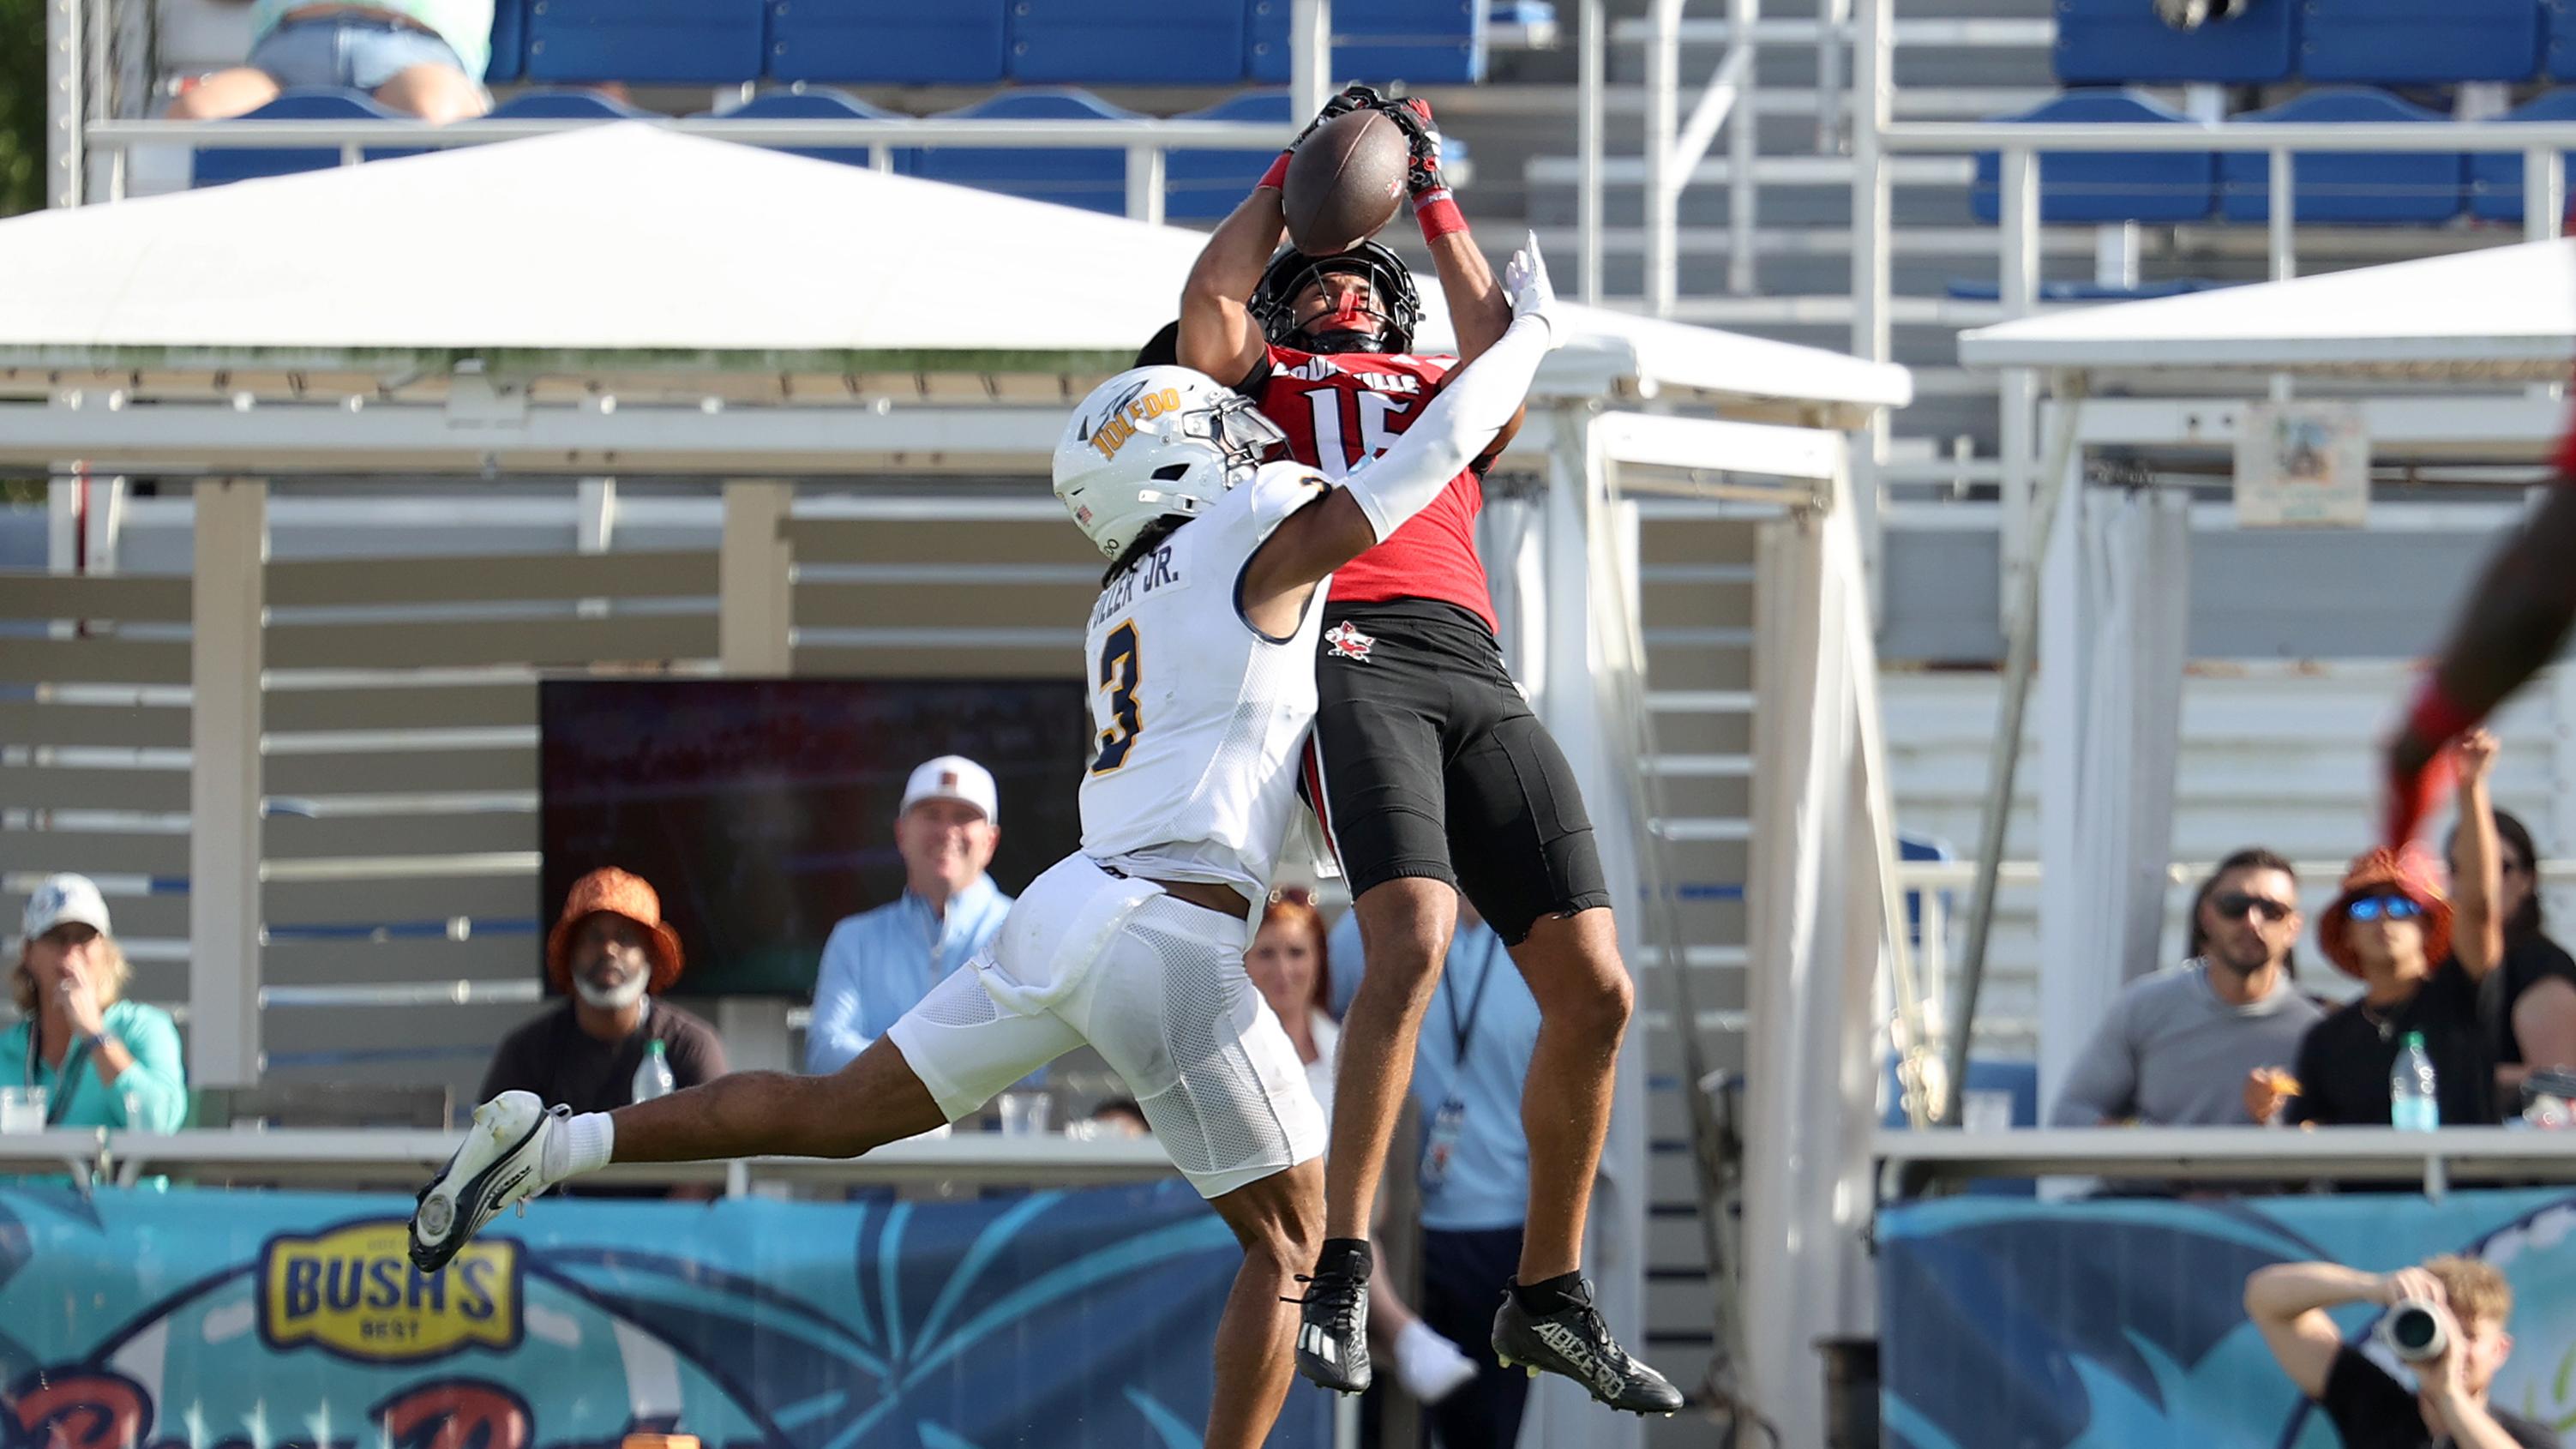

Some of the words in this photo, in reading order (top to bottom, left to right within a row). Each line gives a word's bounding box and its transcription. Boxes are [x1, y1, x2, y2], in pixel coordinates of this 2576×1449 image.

[1090, 387, 1180, 461] TOLEDO
[1143, 545, 1180, 592] JR.
[1089, 616, 1144, 778] 3
[285, 1256, 496, 1321] BUSH'S
